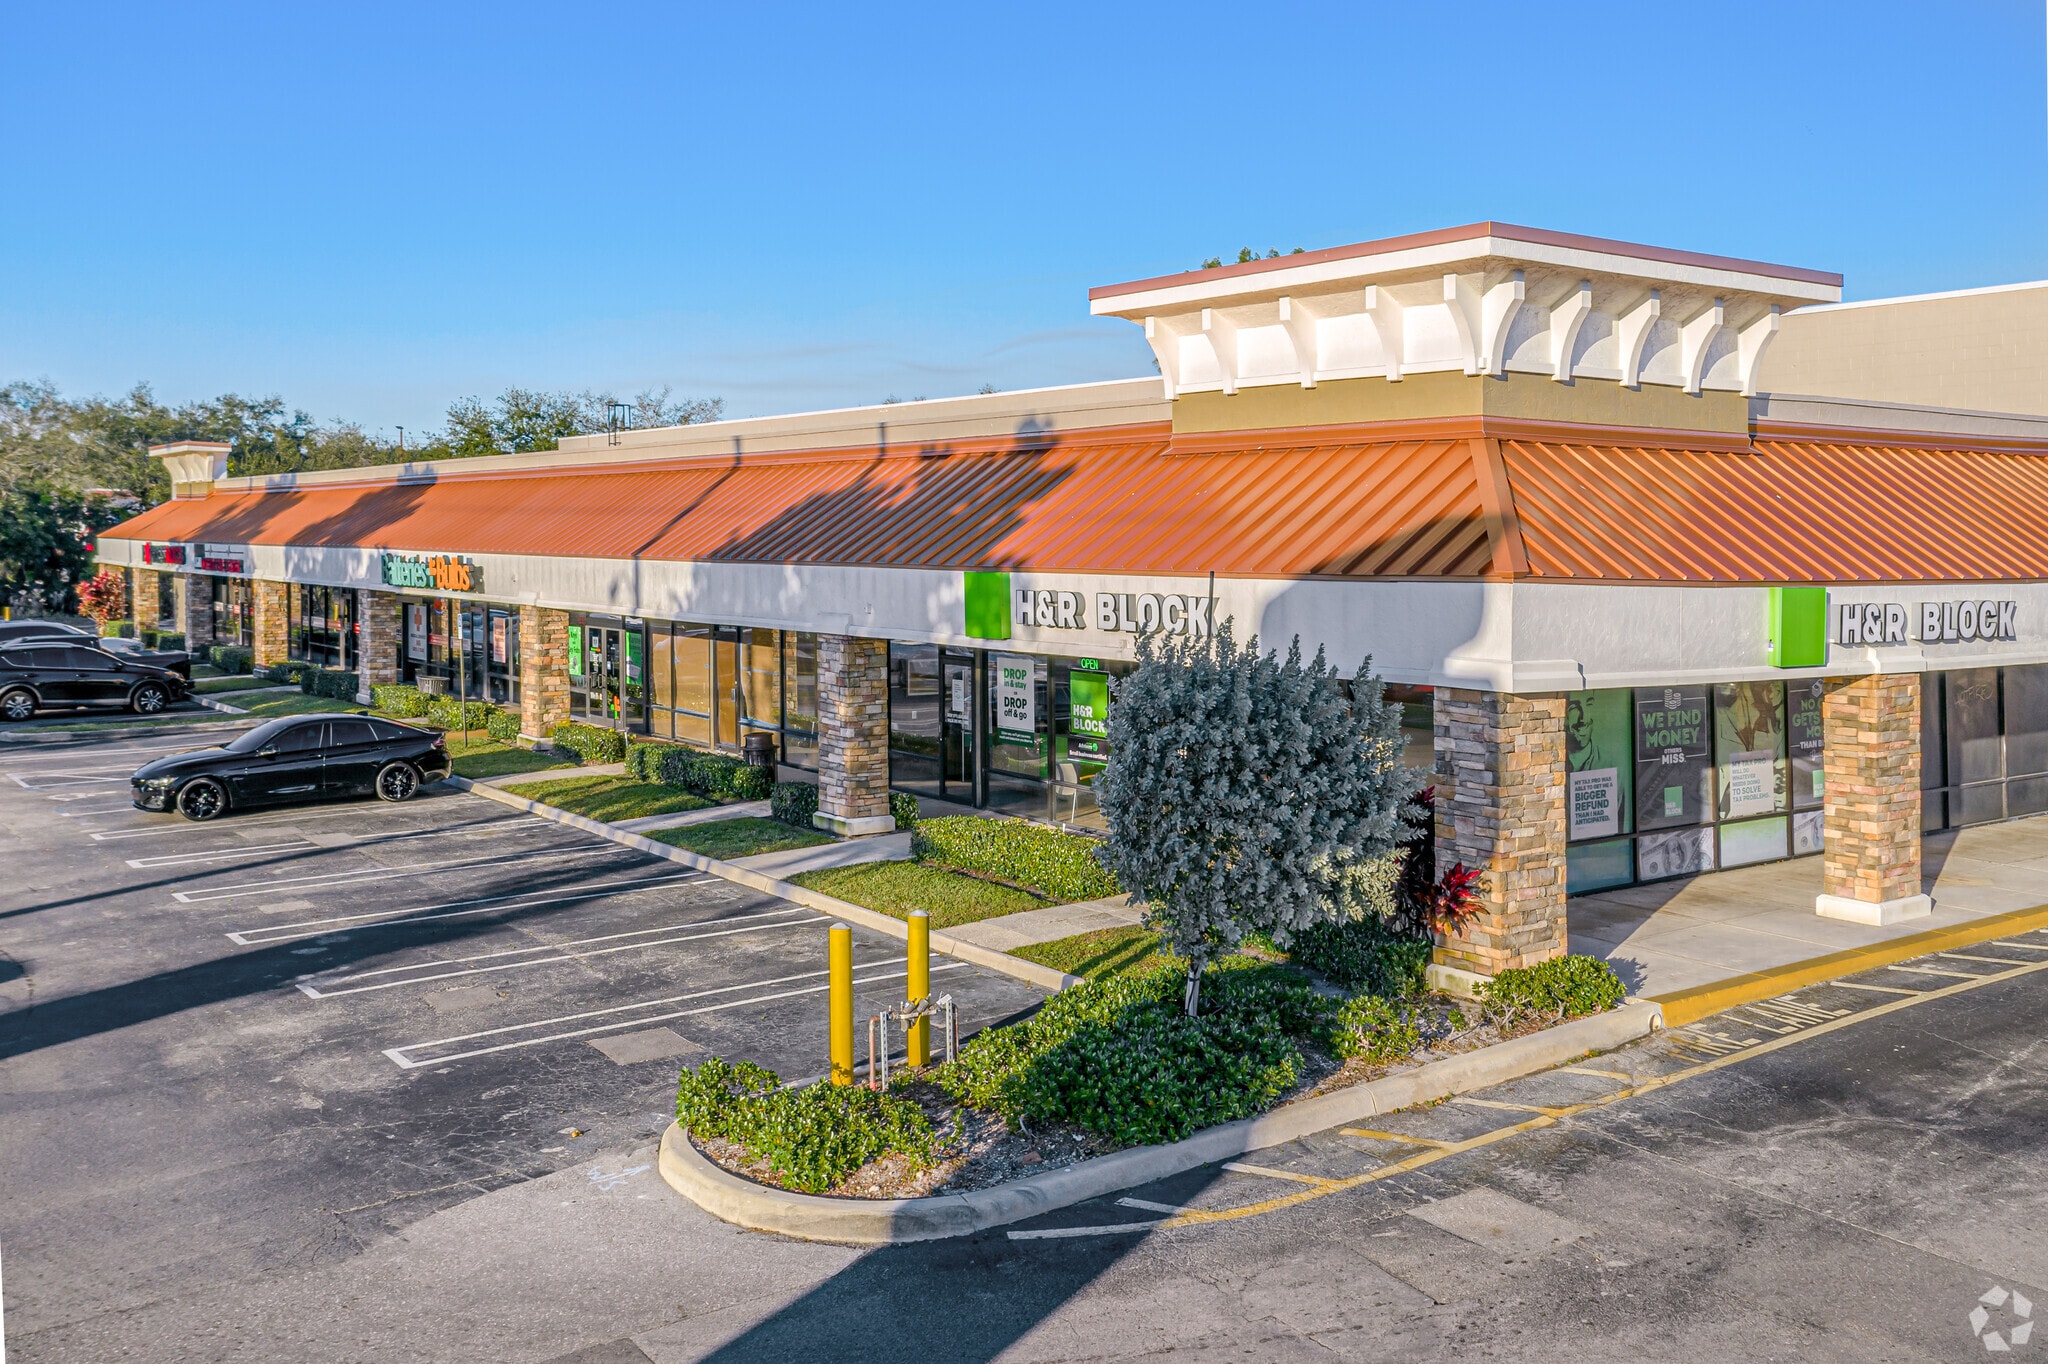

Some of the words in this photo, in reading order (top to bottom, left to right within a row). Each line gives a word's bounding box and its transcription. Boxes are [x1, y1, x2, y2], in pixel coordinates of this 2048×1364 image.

[436, 556, 470, 590] Bulbs
[1015, 590, 1085, 629] H&R
[1096, 592, 1219, 636] BLOCK
[1840, 603, 1906, 644] H&R
[1921, 600, 2017, 640] BLOCK
[1081, 658, 1099, 670] OPEN
[1003, 667, 1027, 680] DROP
[1015, 681, 1027, 690] stay
[1004, 696, 1028, 709] DROP
[1801, 698, 1815, 711] NO
[1004, 708, 1013, 717] off
[1013, 709, 1018, 718] &
[1019, 712, 1028, 720] go
[1073, 704, 1093, 718] H&R
[1642, 712, 1664, 728] WE
[1667, 709, 1702, 727] FIND
[1792, 711, 1820, 727] GETS
[1073, 718, 1105, 733] BLOCK
[1645, 727, 1700, 749] MONEY
[1806, 727, 1821, 738] MO
[1800, 741, 1818, 749] THAN
[1661, 753, 1687, 765] MISS.
[1575, 790, 1607, 802] BIGGER
[1732, 788, 1741, 796] TO
[1742, 785, 1762, 795] SOLVE
[1575, 799, 1609, 812] REFUND
[1575, 811, 1589, 819] THAN
